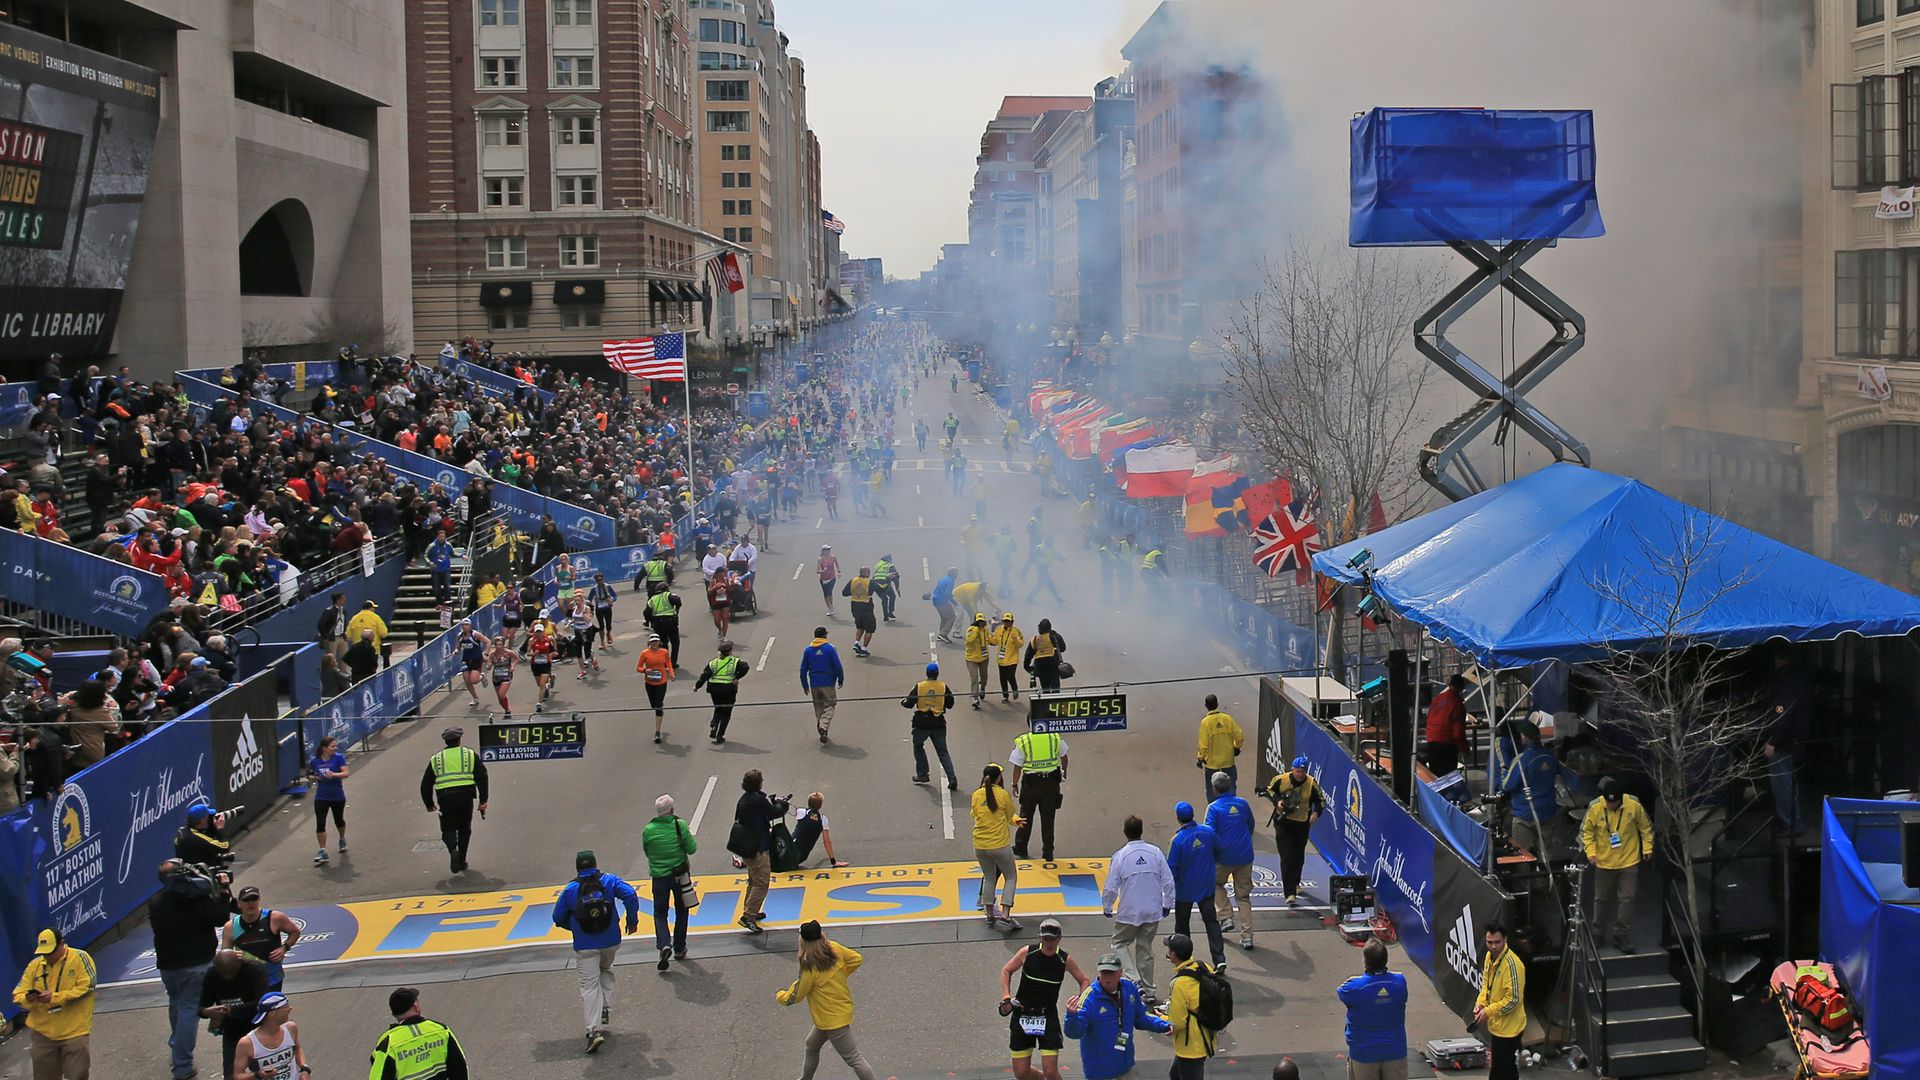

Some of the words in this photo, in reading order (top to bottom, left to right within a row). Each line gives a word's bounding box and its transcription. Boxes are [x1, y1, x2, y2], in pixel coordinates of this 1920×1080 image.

[14, 46, 40, 65] VENUES
[45, 55, 80, 76] EXHIBITION
[81, 66, 97, 81] OPEN
[98, 71, 124, 88] THROUGH
[124, 79, 136, 92] MAY
[31, 312, 106, 338] LIBRARY
[691, 371, 722, 380] LENX
[13, 565, 45, 582] DAY
[94, 589, 117, 601] BOSTON
[116, 597, 149, 611] MARATHON
[1048, 698, 1121, 718] 4:09:55
[498, 725, 578, 745] 4:09:55
[498, 752, 540, 760] MARATHON
[514, 746, 540, 754] BOSTON
[229, 754, 264, 793] adidas
[65, 838, 102, 876] BOSTON
[47, 856, 103, 909] MARATHON
[734, 867, 935, 886] MRATHON
[1018, 862, 1103, 872] 2013
[374, 872, 1104, 951] FINISH
[262, 1050, 292, 1067] ALAN
